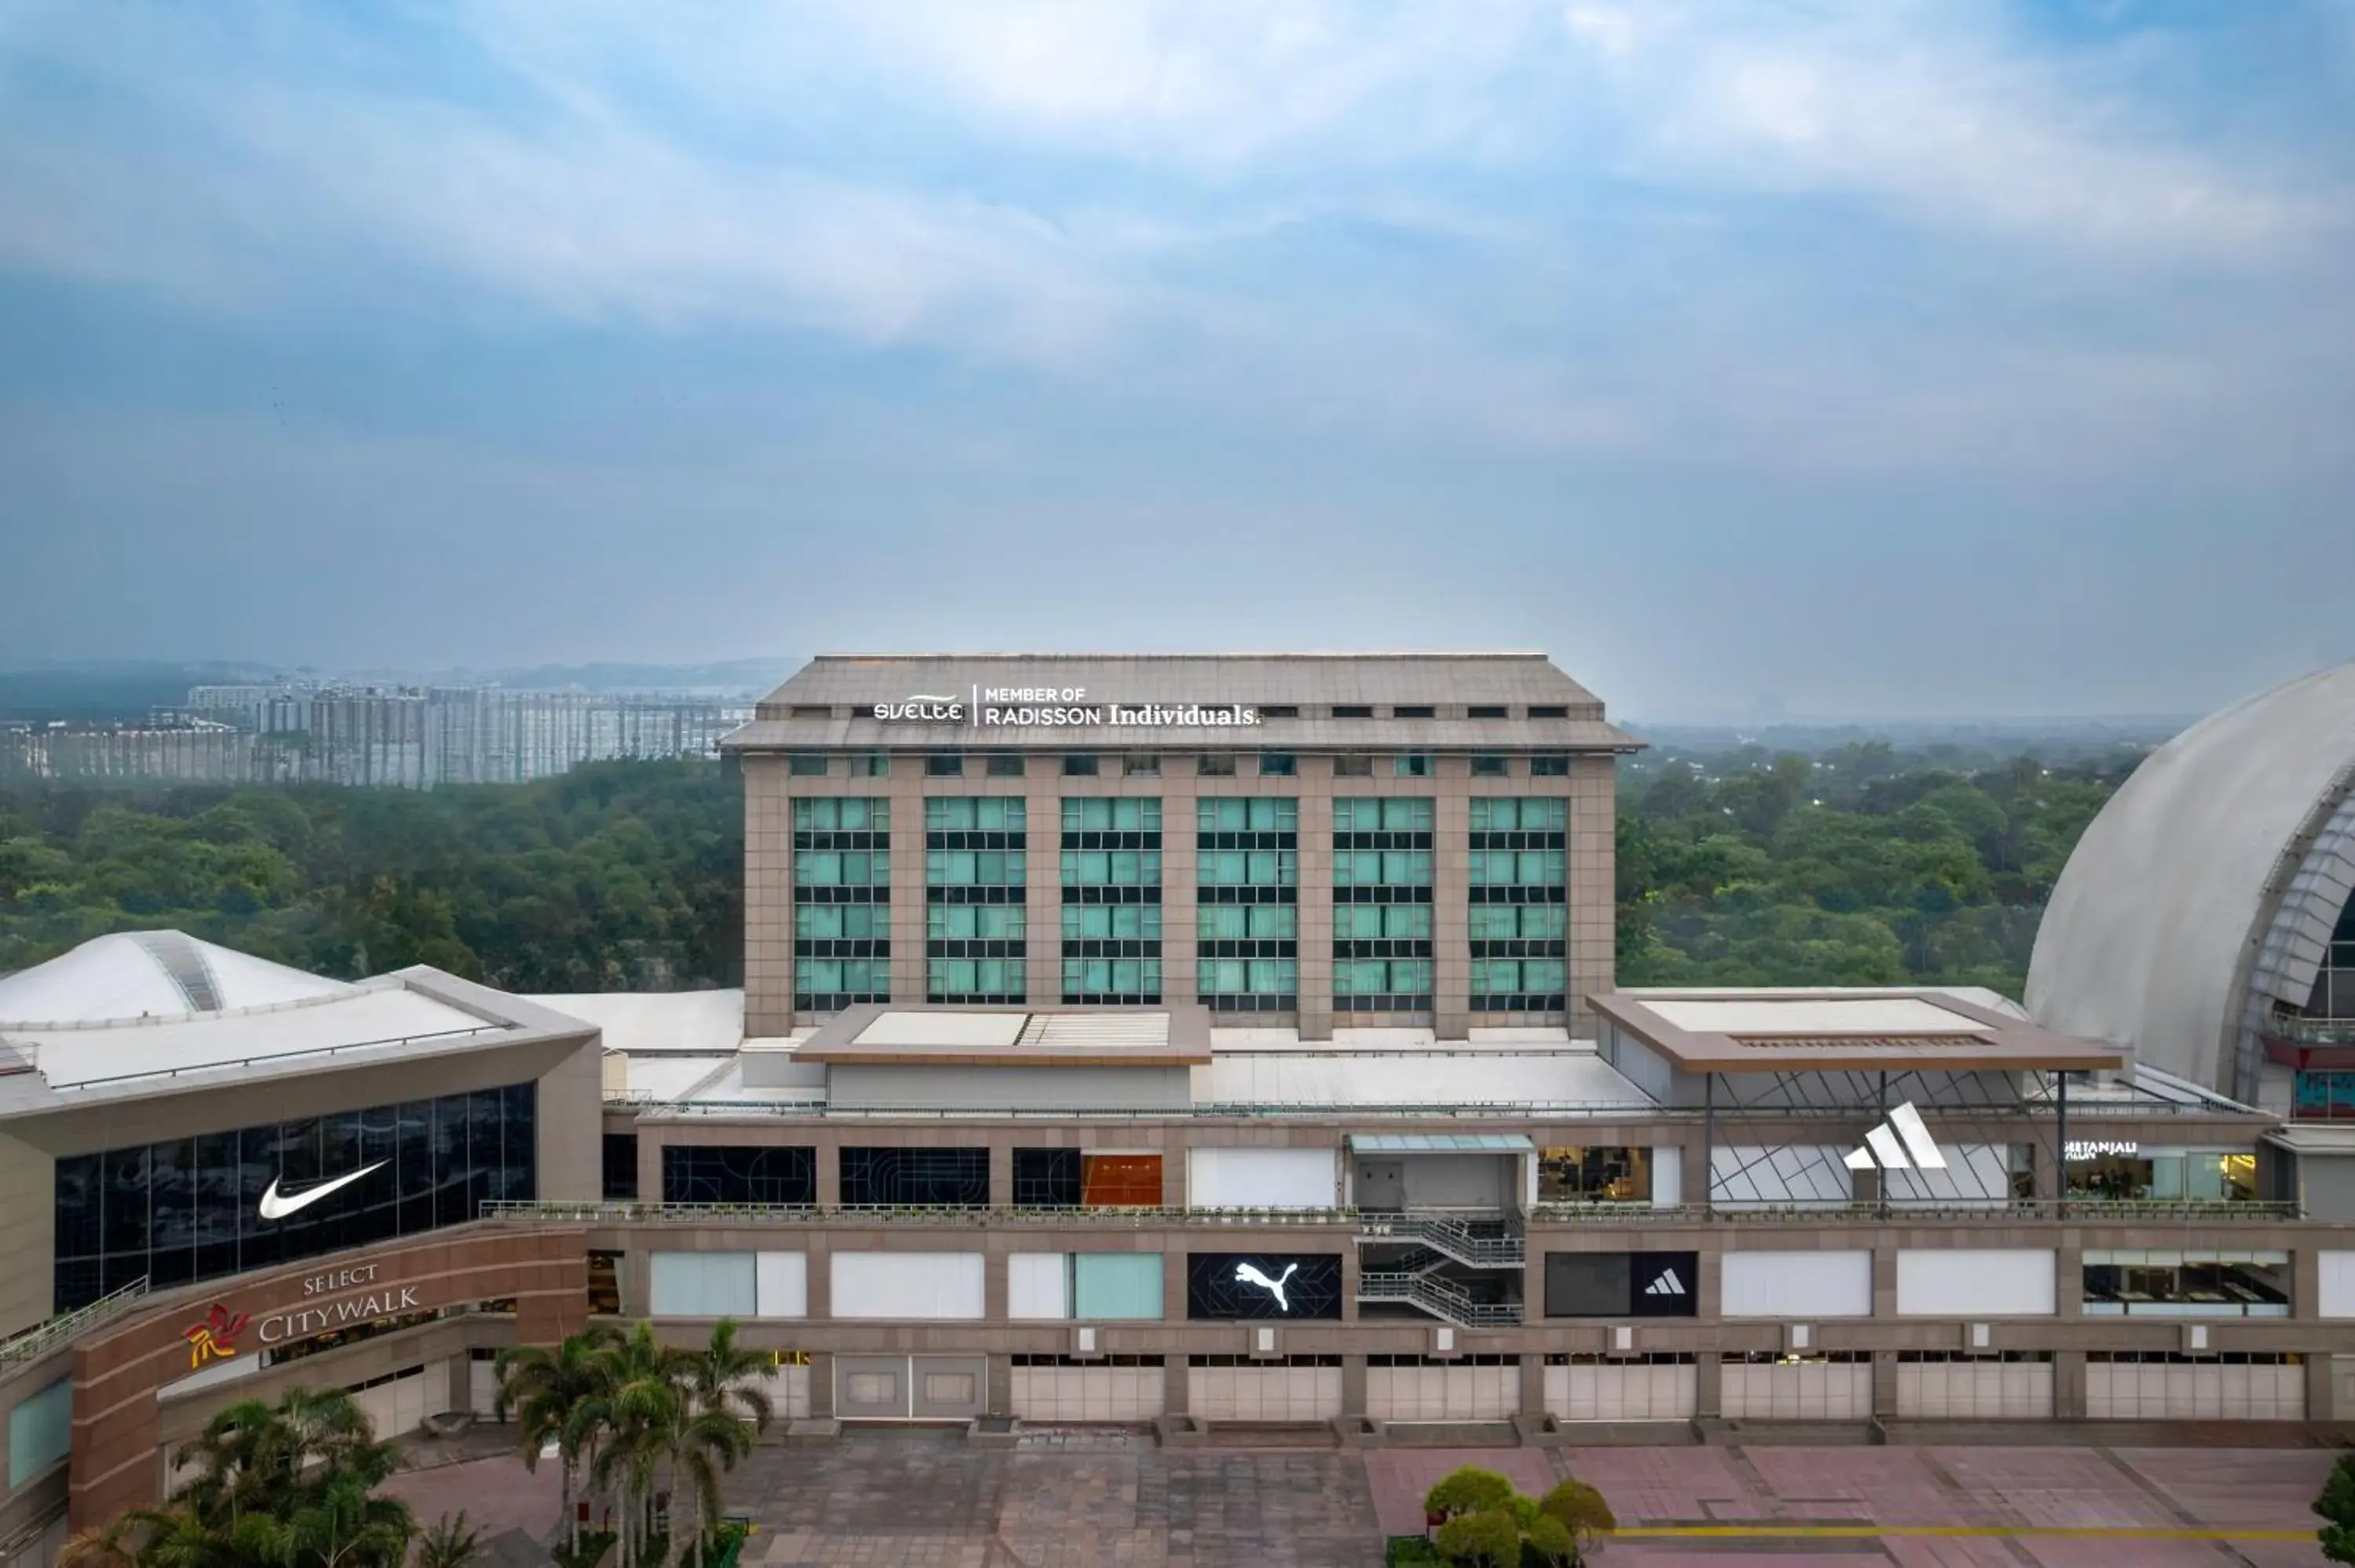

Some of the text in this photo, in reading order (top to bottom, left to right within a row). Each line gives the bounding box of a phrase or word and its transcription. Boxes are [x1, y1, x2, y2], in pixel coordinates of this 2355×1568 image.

[985, 687, 1086, 702] MEMBER OF
[986, 707, 1100, 726] RADISSON
[303, 1264, 378, 1295] SELECT
[259, 1286, 420, 1343] CITYWALK
